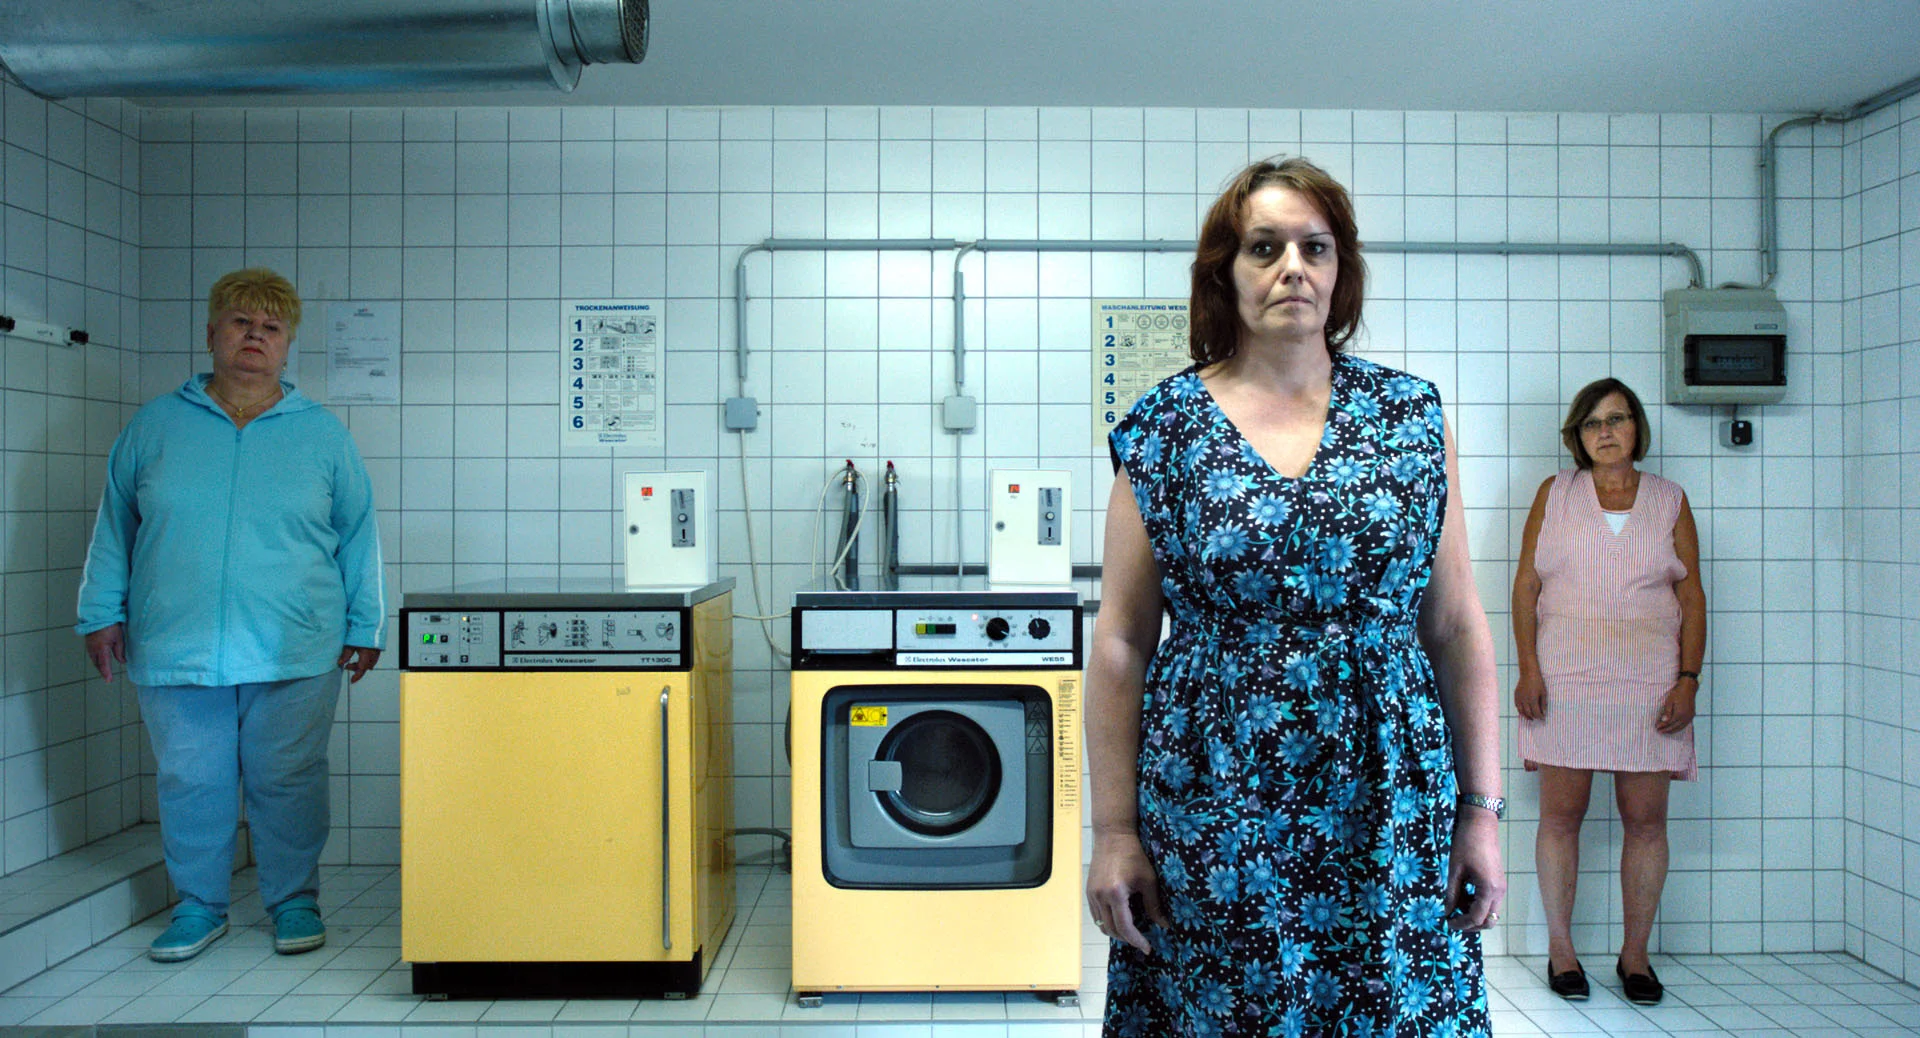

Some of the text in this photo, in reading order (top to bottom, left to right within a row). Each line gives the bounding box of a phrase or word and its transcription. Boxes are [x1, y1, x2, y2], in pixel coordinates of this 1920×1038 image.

[575, 319, 582, 332] 1
[1106, 316, 1113, 329] 1
[573, 338, 584, 351] 2
[1104, 334, 1116, 348] 2
[573, 358, 584, 371] 3
[1104, 354, 1116, 367] 3
[573, 377, 584, 390] 4
[1104, 372, 1116, 386] 4
[573, 396, 584, 409] 5
[1105, 391, 1116, 405] 5
[572, 415, 584, 429] 6
[1105, 410, 1116, 424] 6
[519, 656, 553, 664] Electrolux
